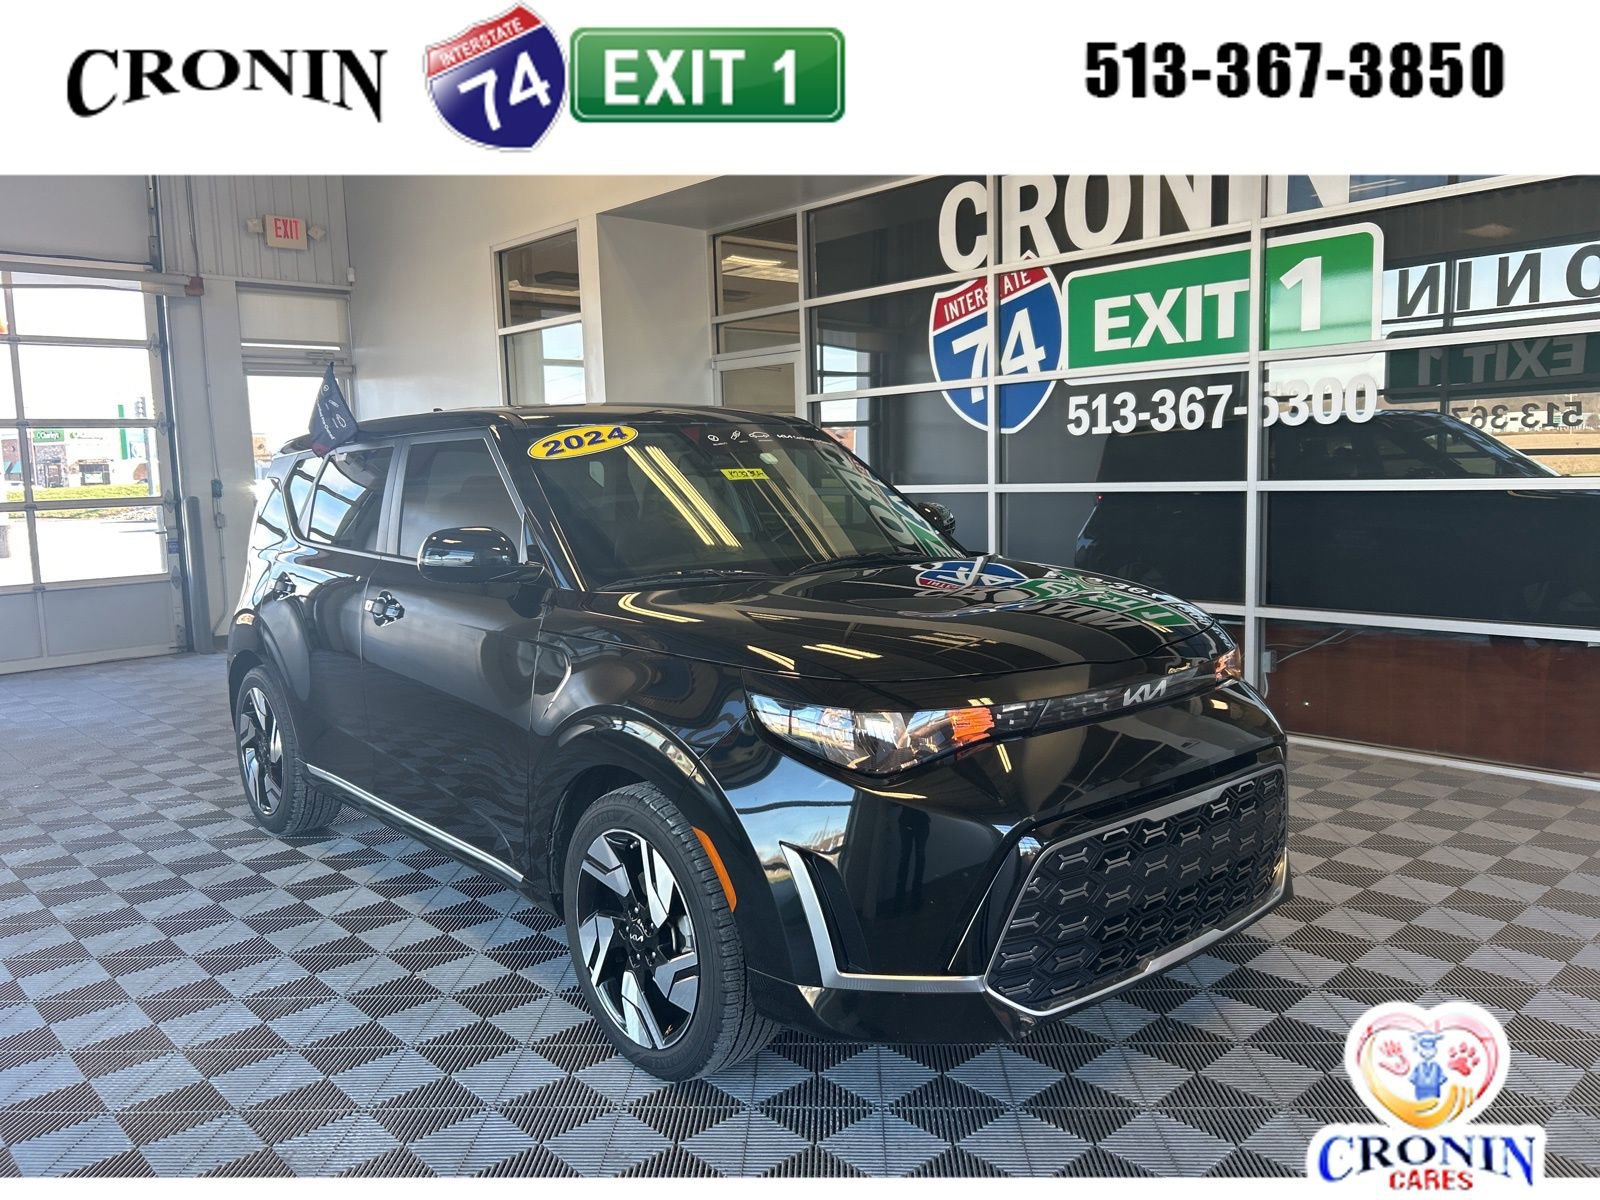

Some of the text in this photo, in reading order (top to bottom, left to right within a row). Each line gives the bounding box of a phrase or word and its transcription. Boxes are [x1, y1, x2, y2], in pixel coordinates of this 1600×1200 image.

[273, 217, 300, 240] EXIT
[1094, 256, 1322, 352] EXIT 1
[952, 307, 1047, 404] 74
[542, 427, 628, 456] 2024
[1122, 679, 1167, 707] KIA
